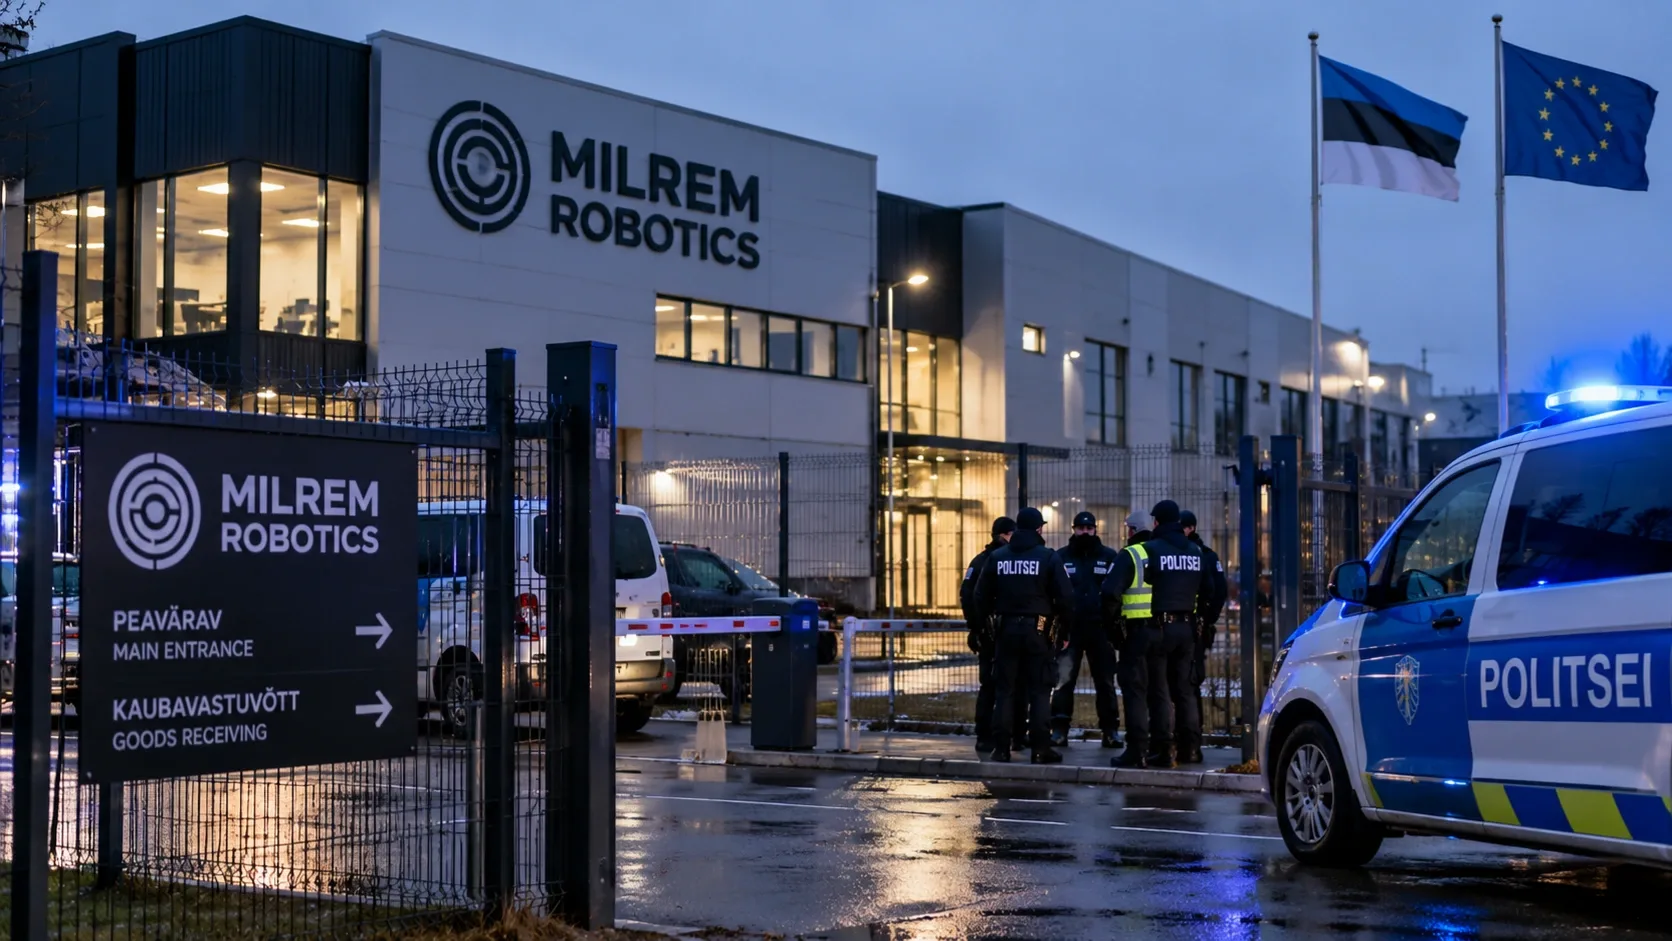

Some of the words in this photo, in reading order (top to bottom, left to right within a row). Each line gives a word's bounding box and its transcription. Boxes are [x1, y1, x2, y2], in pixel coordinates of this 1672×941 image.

[551, 130, 760, 223] MILREM
[550, 194, 761, 270] ROBOTICS
[221, 473, 379, 517] MILREM
[220, 522, 380, 554] ROBOTICS
[997, 560, 1039, 575] POLITSEI
[1160, 554, 1201, 571] POLITSEI
[113, 604, 223, 632] PEAVÄRAV
[113, 642, 159, 661] MAIN
[164, 639, 254, 660] ENTRANCE
[1480, 653, 1652, 708] POLITSEI
[112, 728, 177, 751] GOODS
[182, 723, 268, 746] RECEIVING
